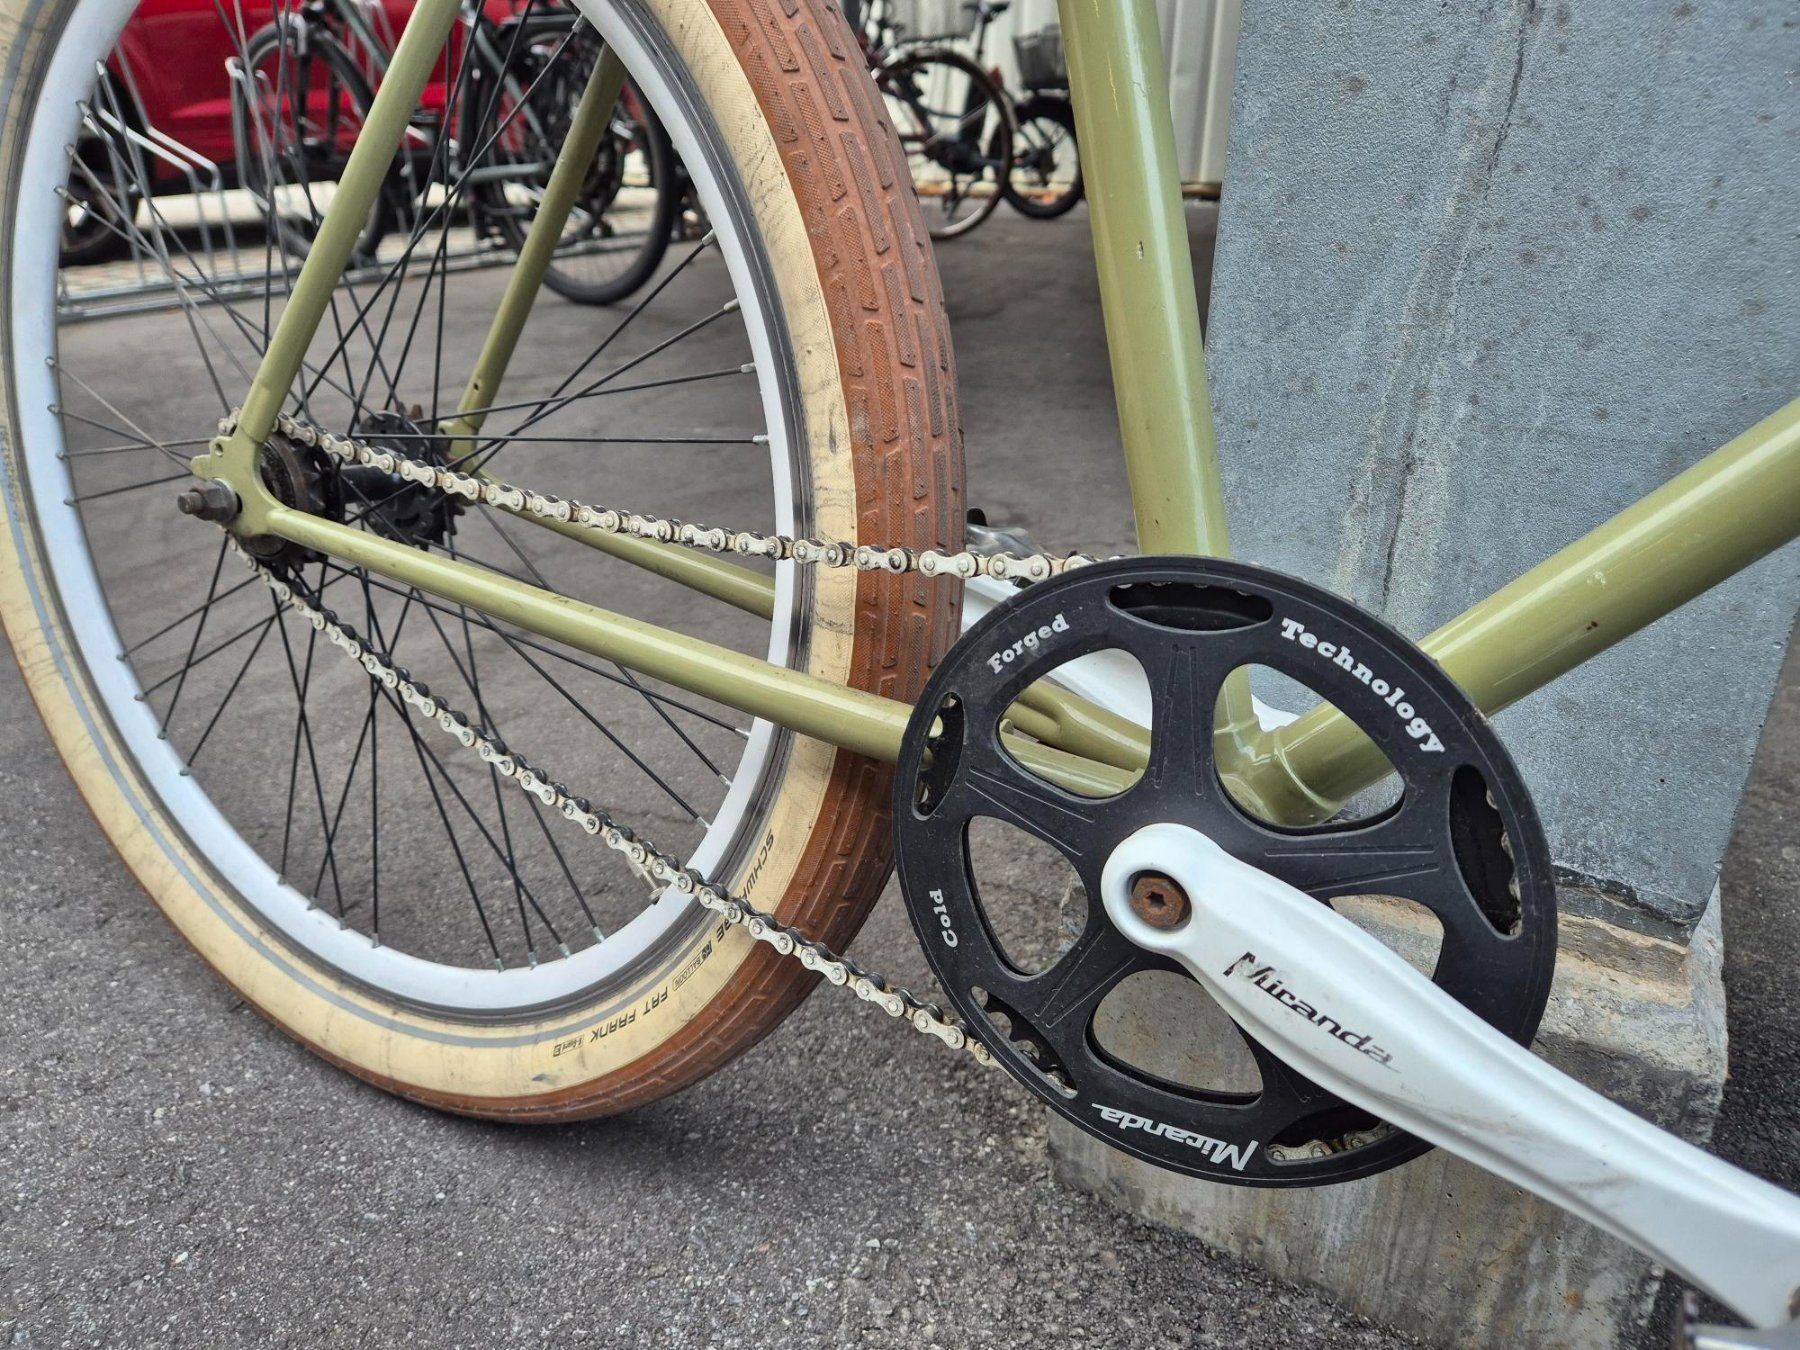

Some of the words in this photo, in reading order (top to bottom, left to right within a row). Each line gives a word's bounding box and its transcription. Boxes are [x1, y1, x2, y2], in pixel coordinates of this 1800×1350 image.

[929, 888, 959, 948] Cold
[986, 613, 1070, 675] Forged
[1280, 617, 1446, 753] Technology
[590, 1008, 636, 1043] FRANK
[642, 986, 668, 1016] FAT
[1222, 951, 1402, 1074] Miranda
[1091, 1102, 1260, 1172] Miranda
